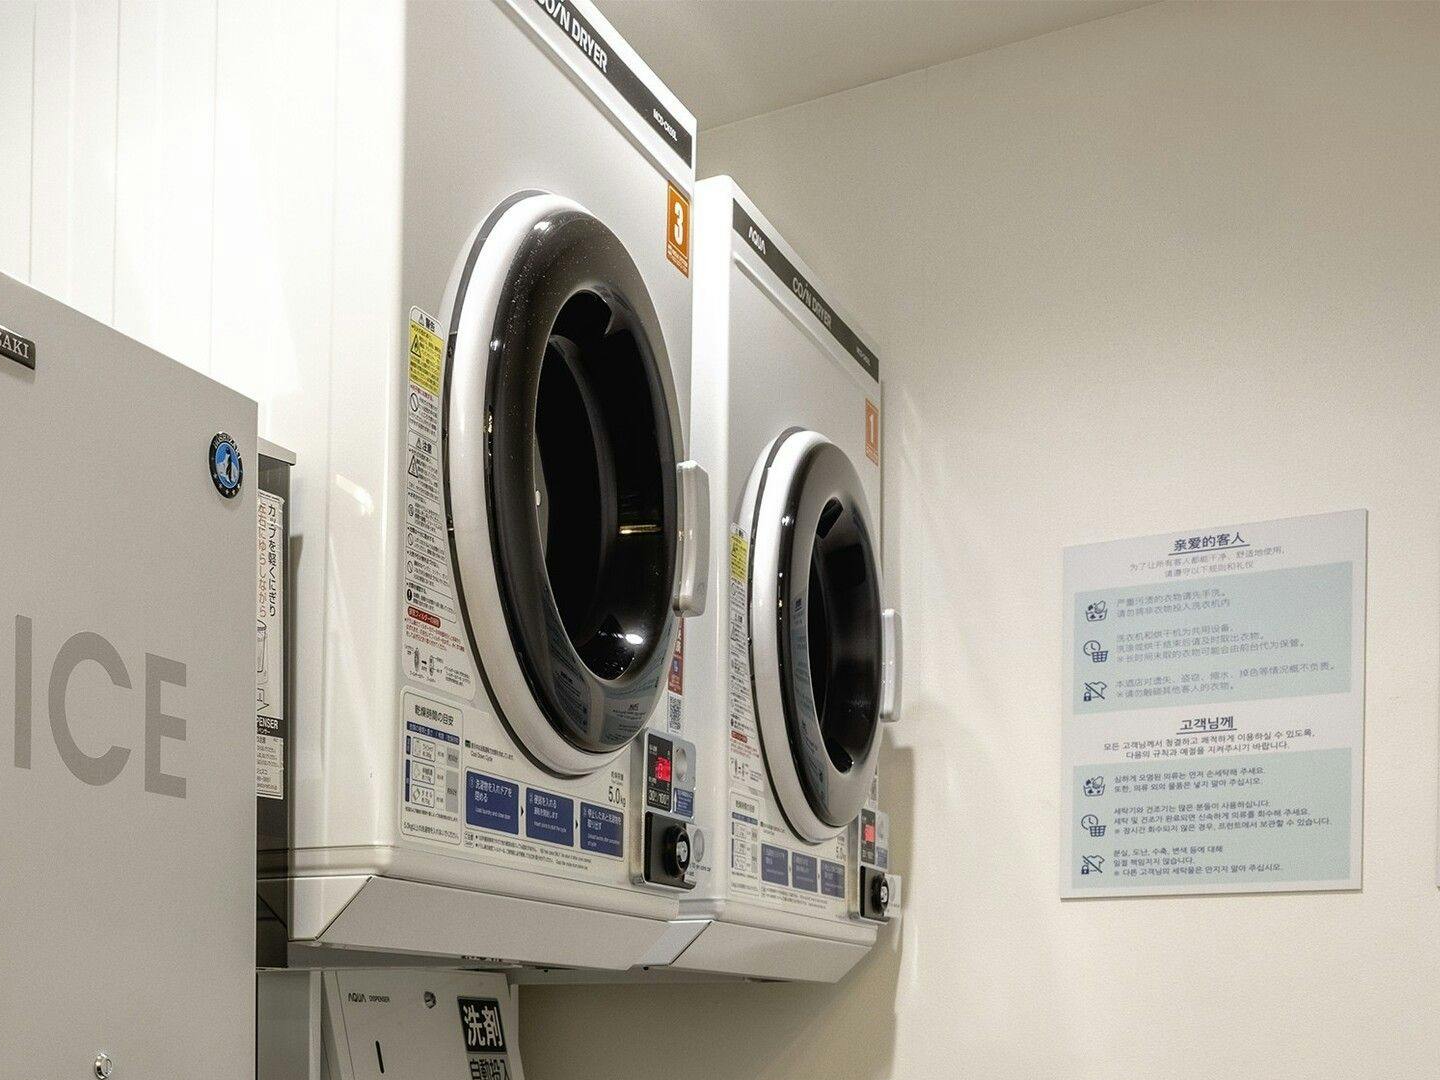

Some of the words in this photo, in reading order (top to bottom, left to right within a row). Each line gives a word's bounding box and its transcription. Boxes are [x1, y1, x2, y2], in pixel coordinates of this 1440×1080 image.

[572, 18, 608, 73] DRYER
[674, 201, 684, 246] 3
[748, 226, 766, 255] AQUA
[811, 299, 832, 331] DRYER
[868, 414, 875, 444] 1
[1173, 531, 1245, 551] 亲爱的客人
[14, 614, 187, 799] ICE
[1179, 716, 1234, 731] 고객님께
[1123, 740, 1163, 750] 고객님께서
[1237, 732, 1271, 741] 이용하실
[462, 1005, 503, 1047] 洗剤
